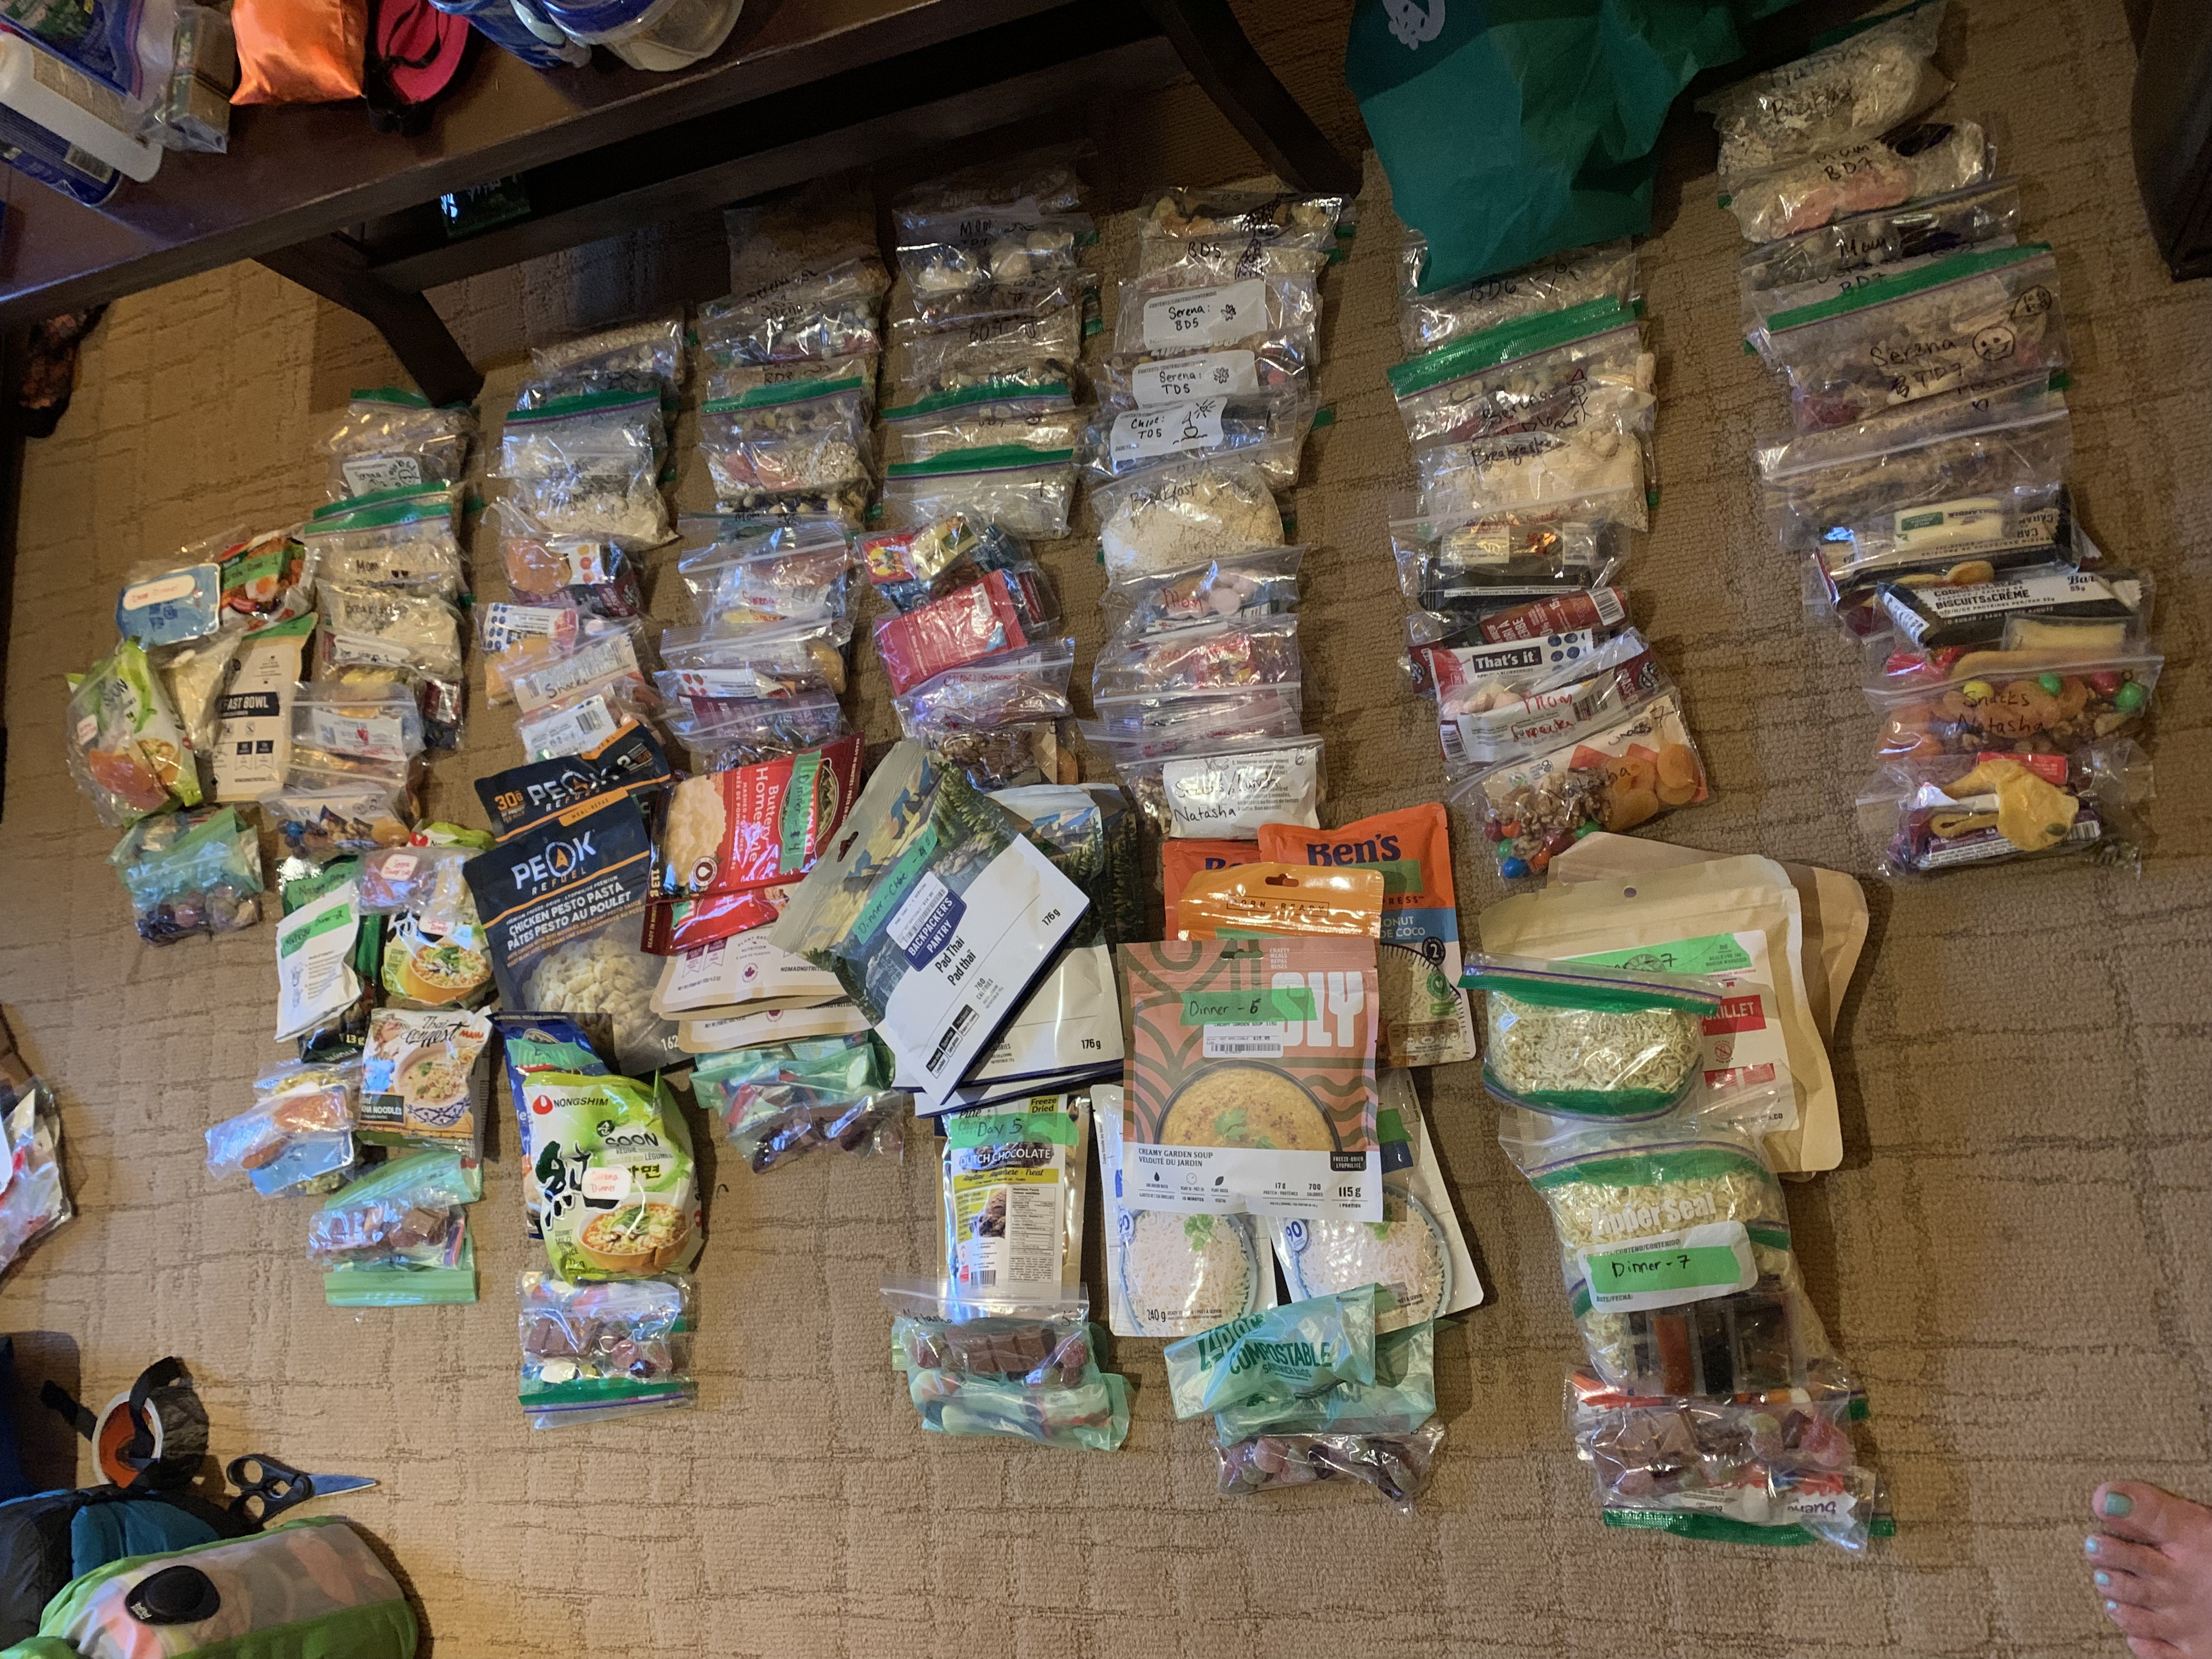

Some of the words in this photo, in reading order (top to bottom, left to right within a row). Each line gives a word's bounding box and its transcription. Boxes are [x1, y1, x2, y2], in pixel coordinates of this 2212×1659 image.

[1175, 317, 1199, 331] BD5
[1161, 383, 1190, 396] TD5
[1475, 651, 1520, 670] That's
[1521, 650, 1537, 664] it
[243, 696, 269, 709] BOWL
[760, 784, 779, 841] Buttery
[1174, 804, 1237, 823] Natasha
[1305, 833, 1402, 867] Ben's
[509, 909, 550, 936] CHICKEN
[551, 896, 586, 918] PESTO
[586, 881, 624, 904] PASTA
[506, 928, 535, 951] PÂTES
[534, 915, 571, 937] PESTO
[571, 906, 588, 923] AU
[589, 890, 633, 917] POULET
[907, 896, 953, 957] BACKPACKER'S
[1041, 912, 1056, 926] 176
[926, 919, 953, 953] PANTRY
[1395, 926, 1426, 938] COCO
[935, 952, 953, 973] Pad
[949, 935, 966, 957] Thai
[1429, 943, 1440, 959] 2
[947, 966, 964, 986] Pad
[960, 949, 977, 970] thaï
[1189, 1000, 1229, 1017] Dinner
[1271, 970, 1365, 1048] SLY
[1081, 1039, 1094, 1049] 176
[1096, 1040, 1102, 1050] g
[553, 1097, 609, 1108] NONGSHIM
[1030, 1097, 1058, 1106] Freeze
[1032, 1104, 1054, 1114] Dried
[372, 1106, 403, 1116] NOODLES
[977, 1120, 1004, 1138] Day
[1009, 1118, 1024, 1135] 5
[605, 1133, 659, 1148] SOON
[960, 1154, 990, 1166] DUTCH
[991, 1148, 1052, 1163] CHOCOLATE
[1138, 1148, 1162, 1156] CREAMY
[1164, 1150, 1192, 1158] GARDEN
[1138, 1155, 1165, 1165] VELOUTÉ
[1177, 1159, 1203, 1167] JARDIN
[1338, 1186, 1354, 1198] 115
[1355, 1187, 1362, 1198] g
[1590, 1197, 1663, 1236] Zipper
[1665, 1191, 1717, 1223] Seal
[1285, 1220, 1303, 1242] 90
[1612, 1260, 1661, 1279] Dinner
[1675, 1254, 1691, 1269] 7
[1596, 1293, 1634, 1303] DATE/FECHA:
[1160, 1311, 1167, 1323] g
[1229, 1341, 1333, 1375] COMPOSTABLE
